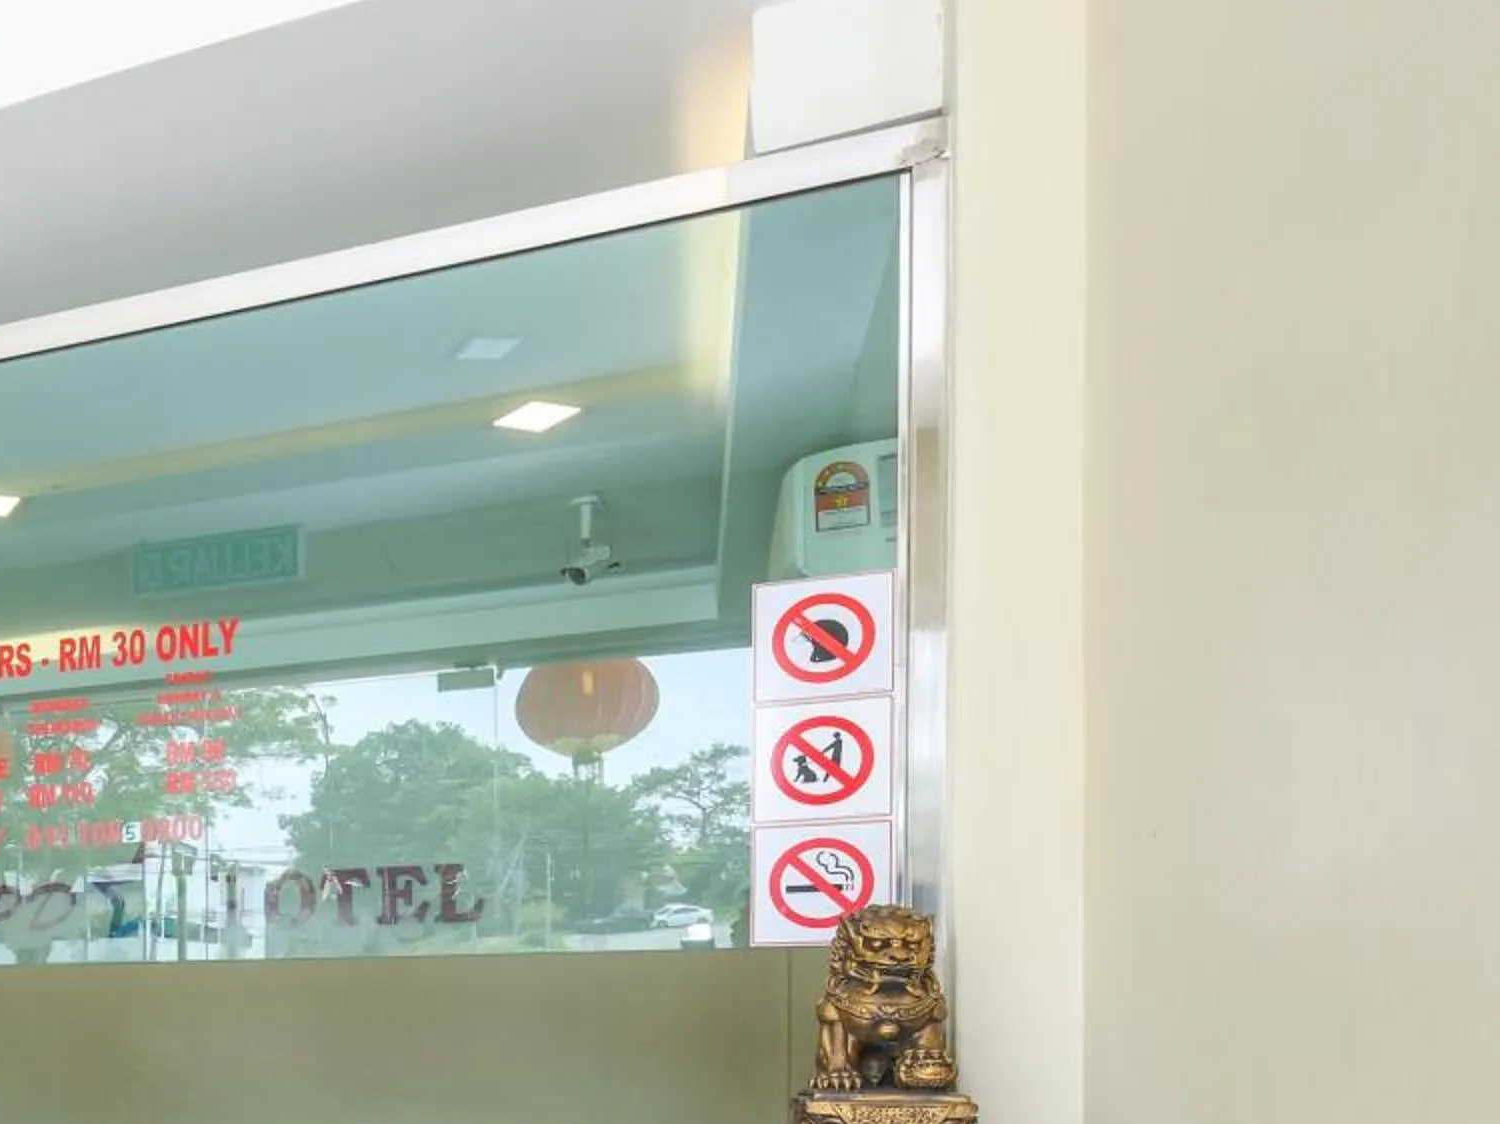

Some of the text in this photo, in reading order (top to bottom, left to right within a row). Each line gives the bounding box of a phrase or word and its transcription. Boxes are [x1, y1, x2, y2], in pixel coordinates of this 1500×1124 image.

[59, 635, 101, 672] RM
[112, 629, 146, 667] 30
[155, 616, 240, 662] ONLY
[220, 863, 485, 926] OTEL
